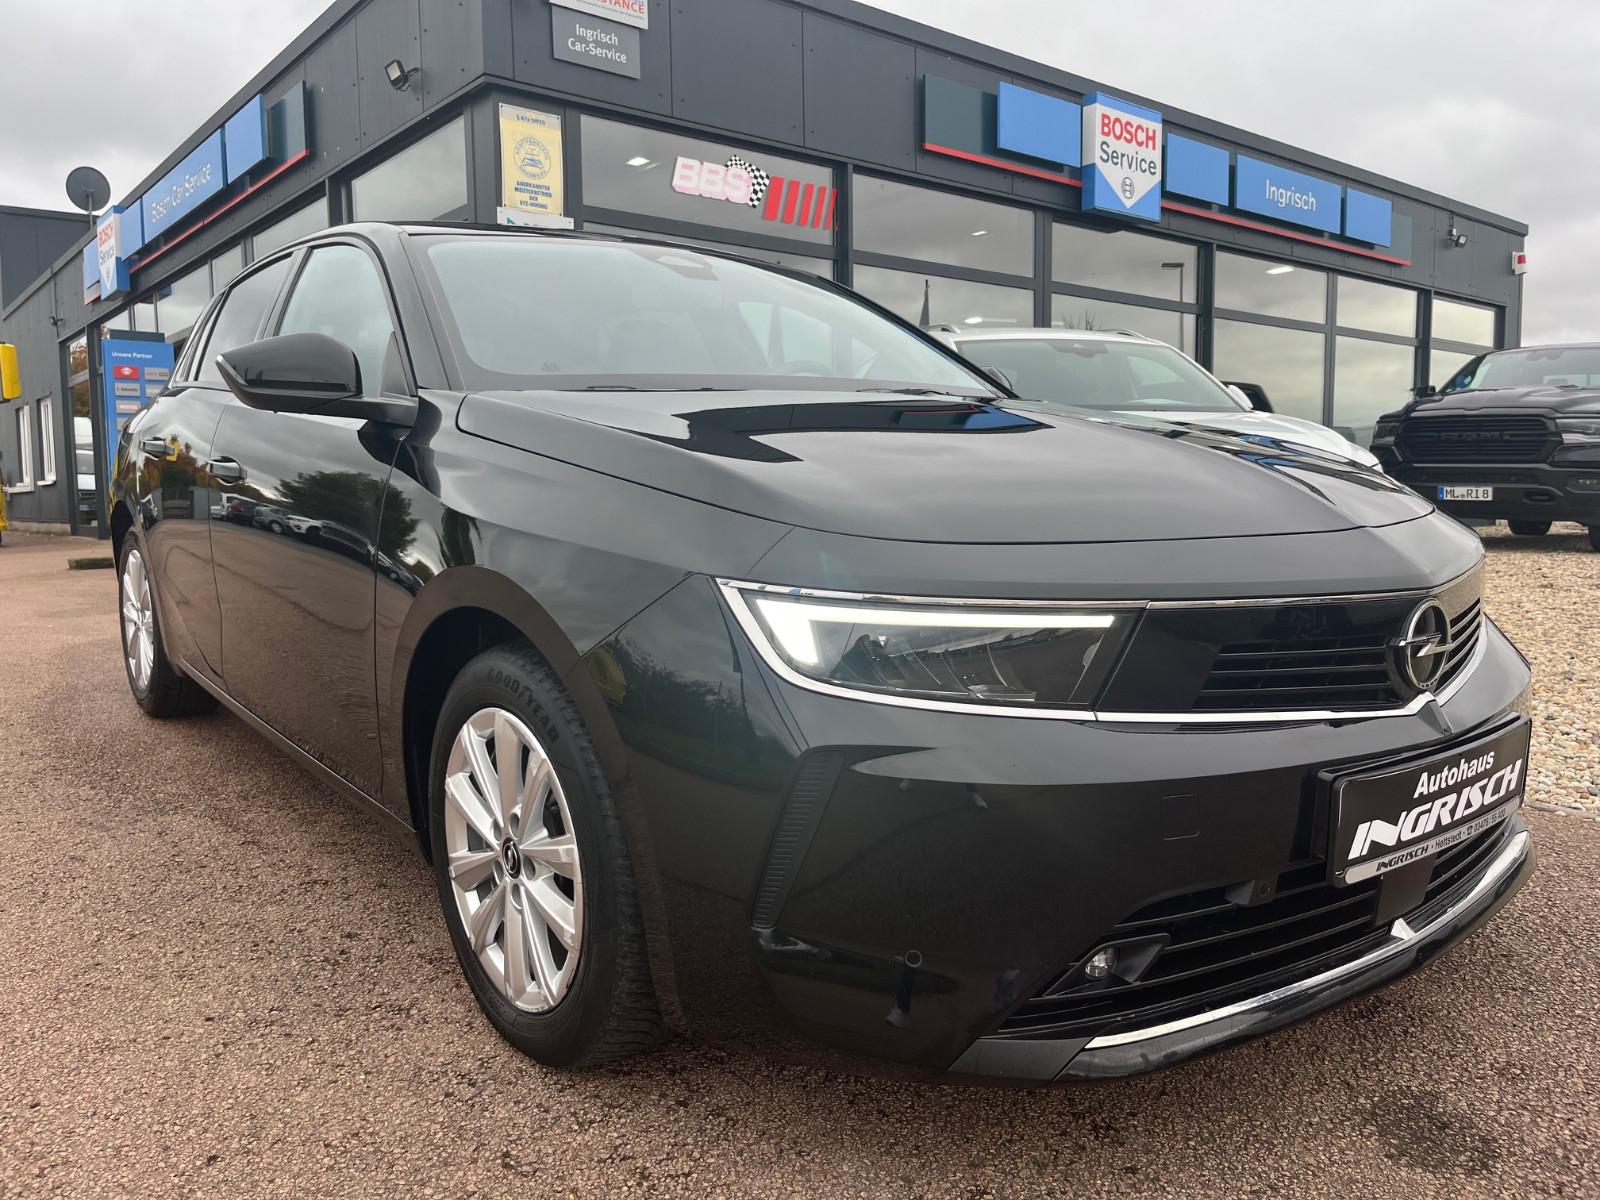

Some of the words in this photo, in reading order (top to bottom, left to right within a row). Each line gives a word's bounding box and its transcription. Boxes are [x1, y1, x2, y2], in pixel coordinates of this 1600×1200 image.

[568, 38, 627, 63] Car-Service
[576, 24, 618, 46] Ingrisch
[1100, 112, 1157, 150] BOSCH
[1100, 140, 1157, 176] Service
[185, 163, 211, 197] Service
[672, 156, 753, 204] BBS
[1265, 179, 1316, 212] Ingrisch
[98, 222, 114, 249] BOSCH
[99, 245, 115, 267] Service
[1445, 488, 1460, 499] ML
[487, 667, 560, 744] GOODYEAR
[1413, 751, 1495, 798] Autohaus
[1348, 758, 1523, 860] INGRISCH
[1376, 844, 1429, 872] INGRISCH
[1435, 830, 1462, 850] Hettstedt
